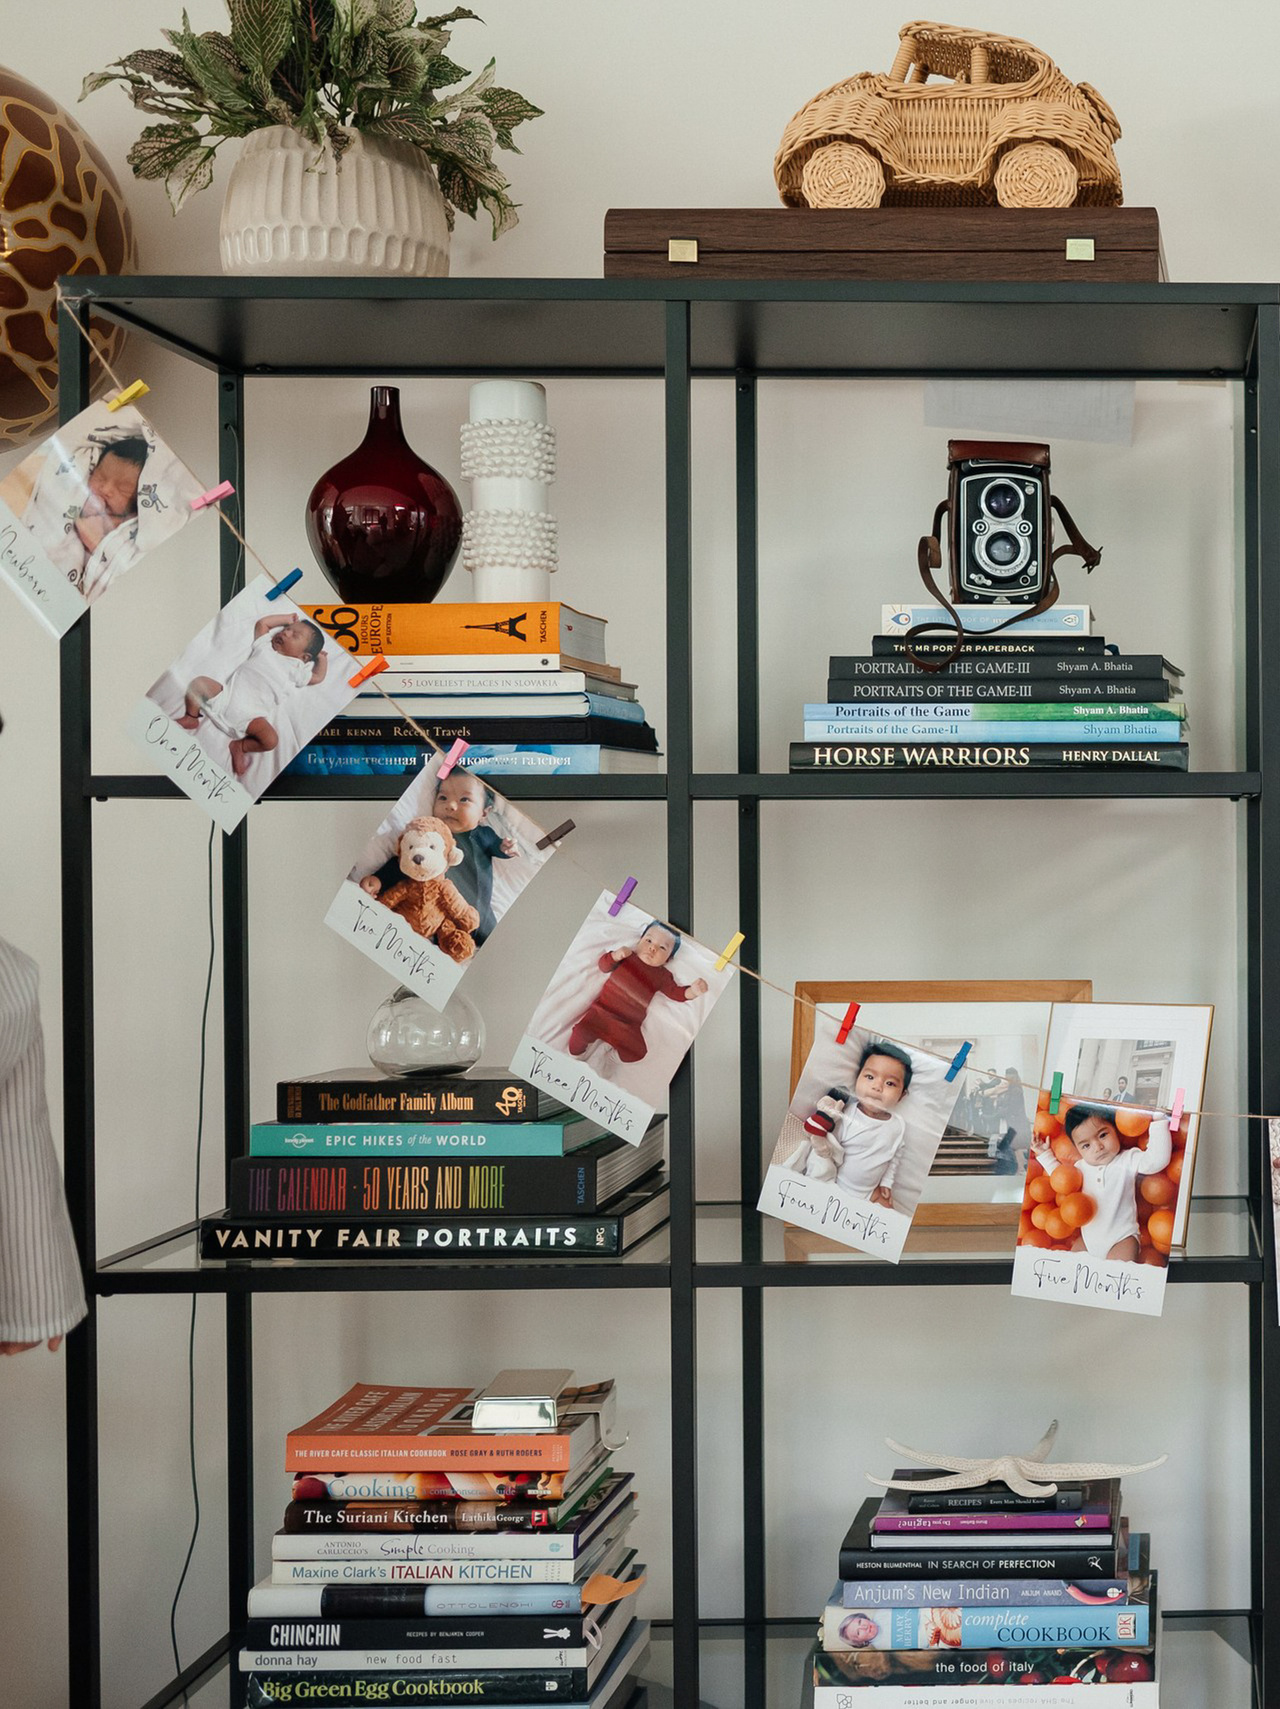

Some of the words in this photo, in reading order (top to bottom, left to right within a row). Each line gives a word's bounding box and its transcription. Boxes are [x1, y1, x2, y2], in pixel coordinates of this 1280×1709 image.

[370, 605, 383, 654] EUROPE
[915, 644, 929, 652] MR
[402, 679, 412, 687] 55
[416, 679, 464, 687] LOVELIEST
[467, 679, 498, 687] PLACES
[501, 679, 511, 687] IN
[515, 679, 558, 687] SLOVAKIA
[835, 705, 890, 718] Portraits
[893, 705, 907, 717] of
[909, 706, 929, 717] the
[933, 706, 970, 717] Game
[1073, 706, 1104, 716] Shyam
[1107, 706, 1117, 714] A.
[1120, 705, 1148, 714] Bhatia
[347, 728, 381, 736] KENNA
[393, 727, 430, 736] Recent
[433, 727, 470, 736] Travels
[146, 715, 178, 754] One
[176, 744, 236, 803] Month
[308, 754, 416, 769] Государственная
[523, 756, 571, 766] галерея
[813, 747, 895, 766] HORSE
[902, 747, 1030, 766] WARRIORS
[1062, 750, 1109, 762] HENRY
[1112, 750, 1160, 762] DALLAL
[350, 900, 377, 935] Two
[375, 926, 435, 985] Months
[529, 1046, 571, 1091] Three
[570, 1076, 634, 1131] Months
[320, 1093, 340, 1111] The
[342, 1093, 397, 1111] Godfather
[400, 1093, 436, 1114] Family
[439, 1093, 473, 1111] Album
[326, 1135, 358, 1146] EPIC
[363, 1135, 403, 1146] HIKES
[408, 1134, 417, 1147] of
[419, 1134, 432, 1145] the
[436, 1134, 486, 1146] WORLD
[250, 1168, 271, 1211] THE
[278, 1168, 347, 1211] CALENDAR
[364, 1168, 379, 1210] 50
[387, 1167, 428, 1210] YEARS
[435, 1167, 461, 1209] AND
[469, 1166, 505, 1209] MORE
[577, 1167, 585, 1204] TASCHEN
[778, 1179, 819, 1215] Four
[820, 1196, 890, 1245] Months
[216, 1229, 322, 1248] VANITY
[338, 1229, 401, 1247] FAIR
[417, 1227, 577, 1246] PORTRAITS
[1033, 1259, 1070, 1289] Five
[1072, 1265, 1145, 1301] Months
[327, 1480, 416, 1499] Cooking
[304, 1510, 332, 1524] The
[336, 1510, 388, 1523] Suriani
[393, 1510, 448, 1523] Kitchen
[293, 1567, 339, 1578] Maxine
[343, 1566, 386, 1577] Clark's
[391, 1566, 452, 1579] ITALIAN
[459, 1565, 531, 1578] KITCHEN
[928, 1561, 938, 1569] IN
[942, 1561, 979, 1569] SEARCH
[999, 1560, 1055, 1568] PERFECTION
[854, 1585, 915, 1603] Anjum's
[923, 1587, 951, 1600] New
[959, 1586, 1010, 1599] Indian
[437, 1601, 533, 1609] OTTOLENGHI
[270, 1624, 340, 1646] CHINCHIN
[965, 1614, 1029, 1631] complete
[998, 1627, 1111, 1642] COOKBOOK
[255, 1655, 293, 1665] donna
[297, 1655, 318, 1668] hay
[936, 1663, 954, 1672] the
[960, 1662, 987, 1672] food
[992, 1662, 1004, 1671] of
[1009, 1662, 1034, 1673] italy
[264, 1683, 292, 1700] Big
[295, 1682, 351, 1697] Green
[355, 1681, 389, 1698] Egg
[392, 1680, 484, 1695] Cookbook
